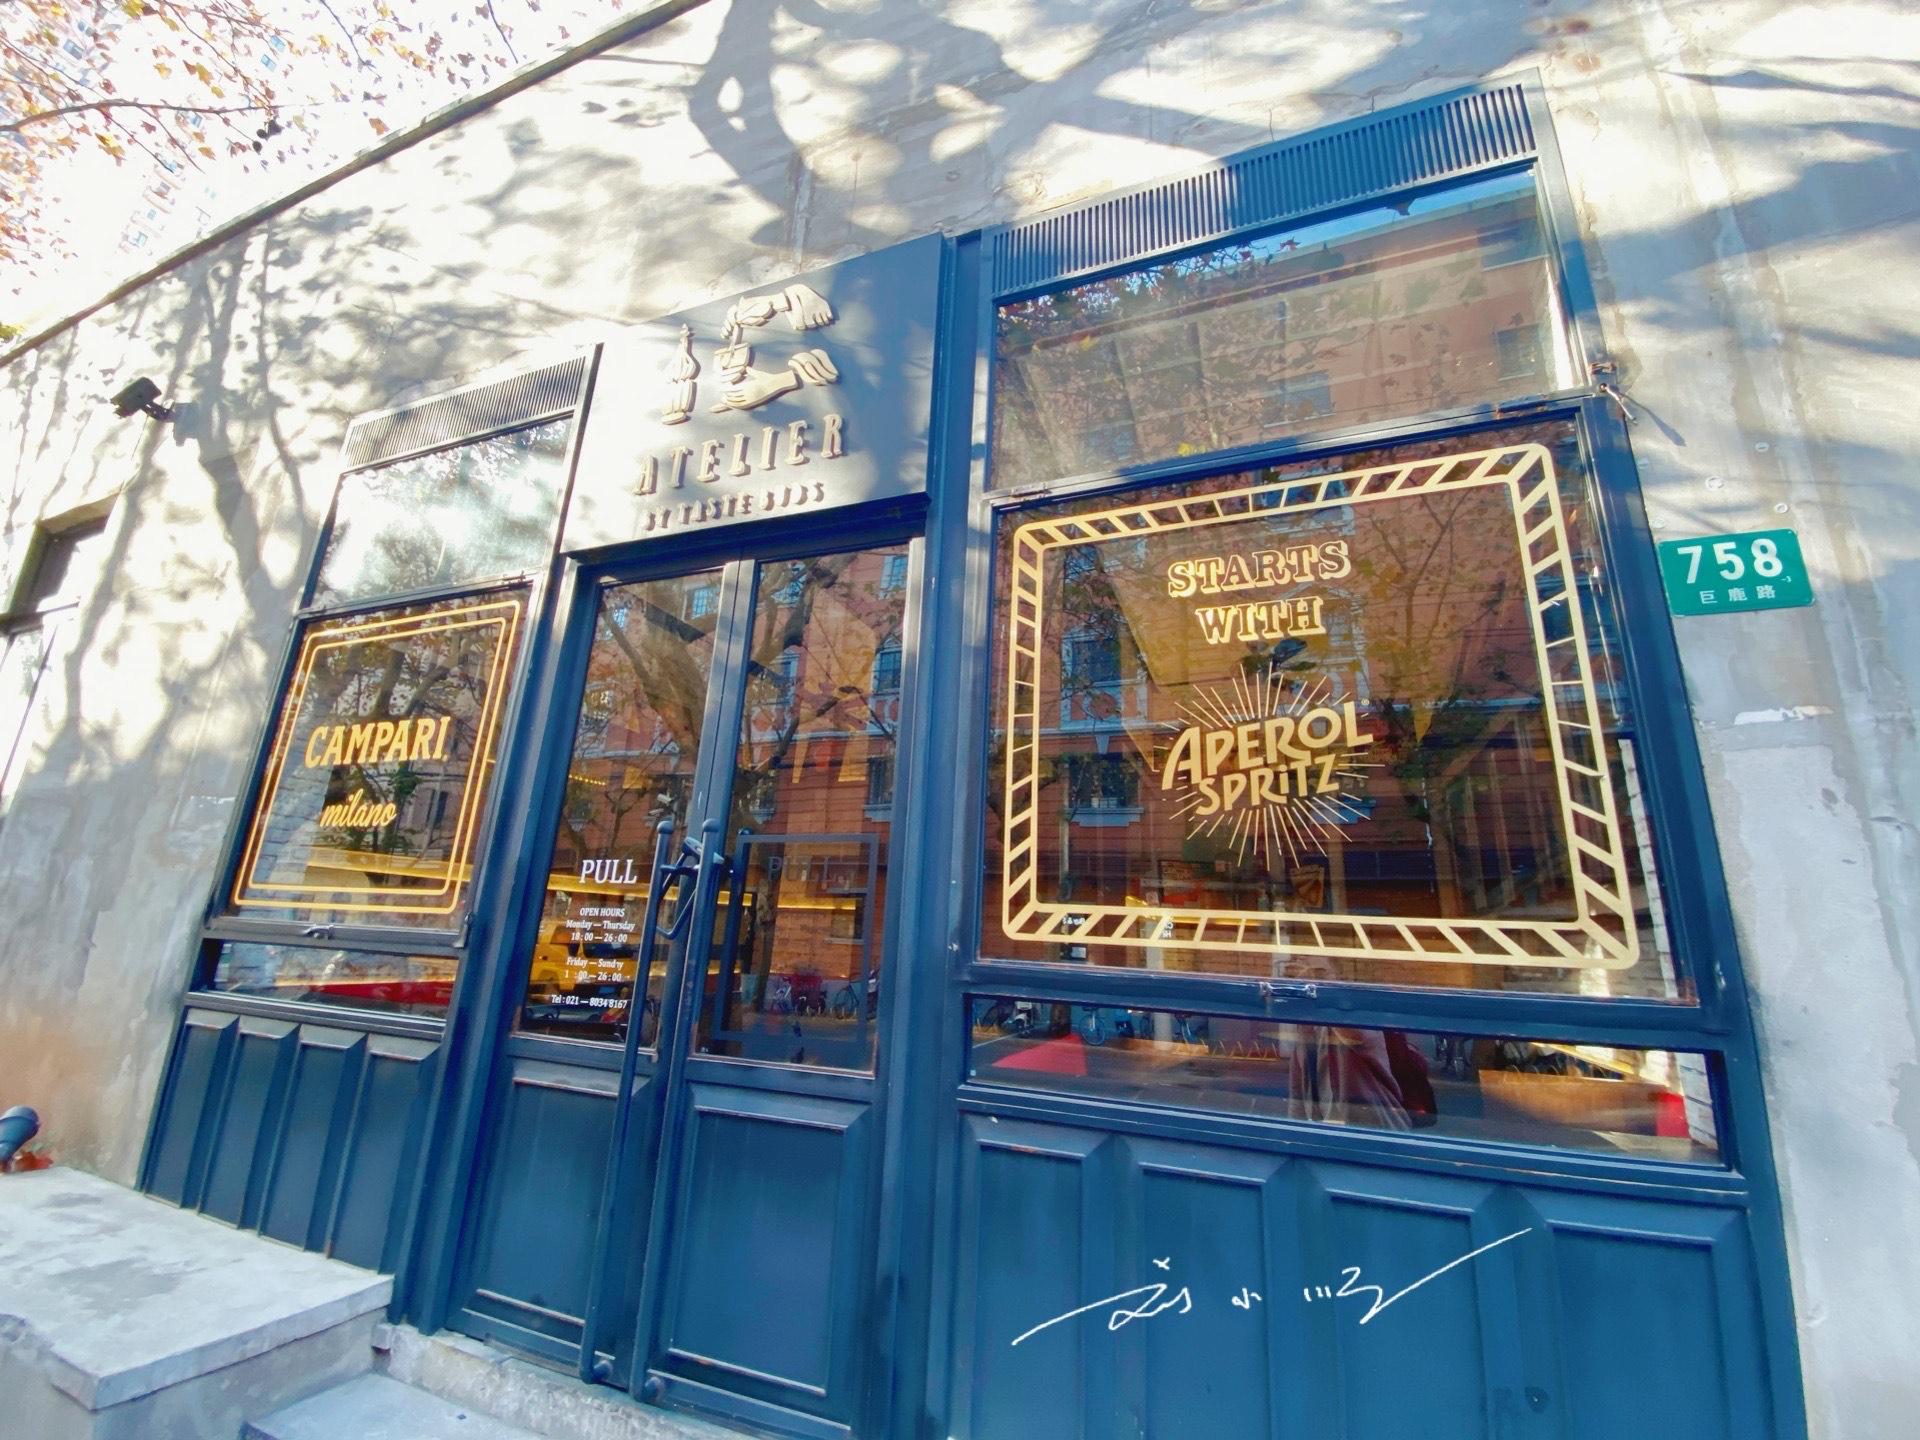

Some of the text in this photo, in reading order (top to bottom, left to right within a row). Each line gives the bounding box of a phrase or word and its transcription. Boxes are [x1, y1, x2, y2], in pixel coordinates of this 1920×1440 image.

[633, 414, 843, 495] ATELIER
[677, 491, 752, 524] TASTE
[1168, 540, 1351, 597] STARTS
[1677, 538, 1783, 584] 758
[1699, 585, 1776, 604] 巨鹿路
[1195, 596, 1327, 644] WITH
[305, 716, 451, 768] CAMPARI
[1161, 701, 1374, 791] APEROL
[320, 788, 398, 828] milano
[579, 859, 638, 884] PULL
[566, 919, 592, 930] Monday
[603, 920, 635, 932] Thursday
[580, 908, 625, 917] OPEN HOURS
